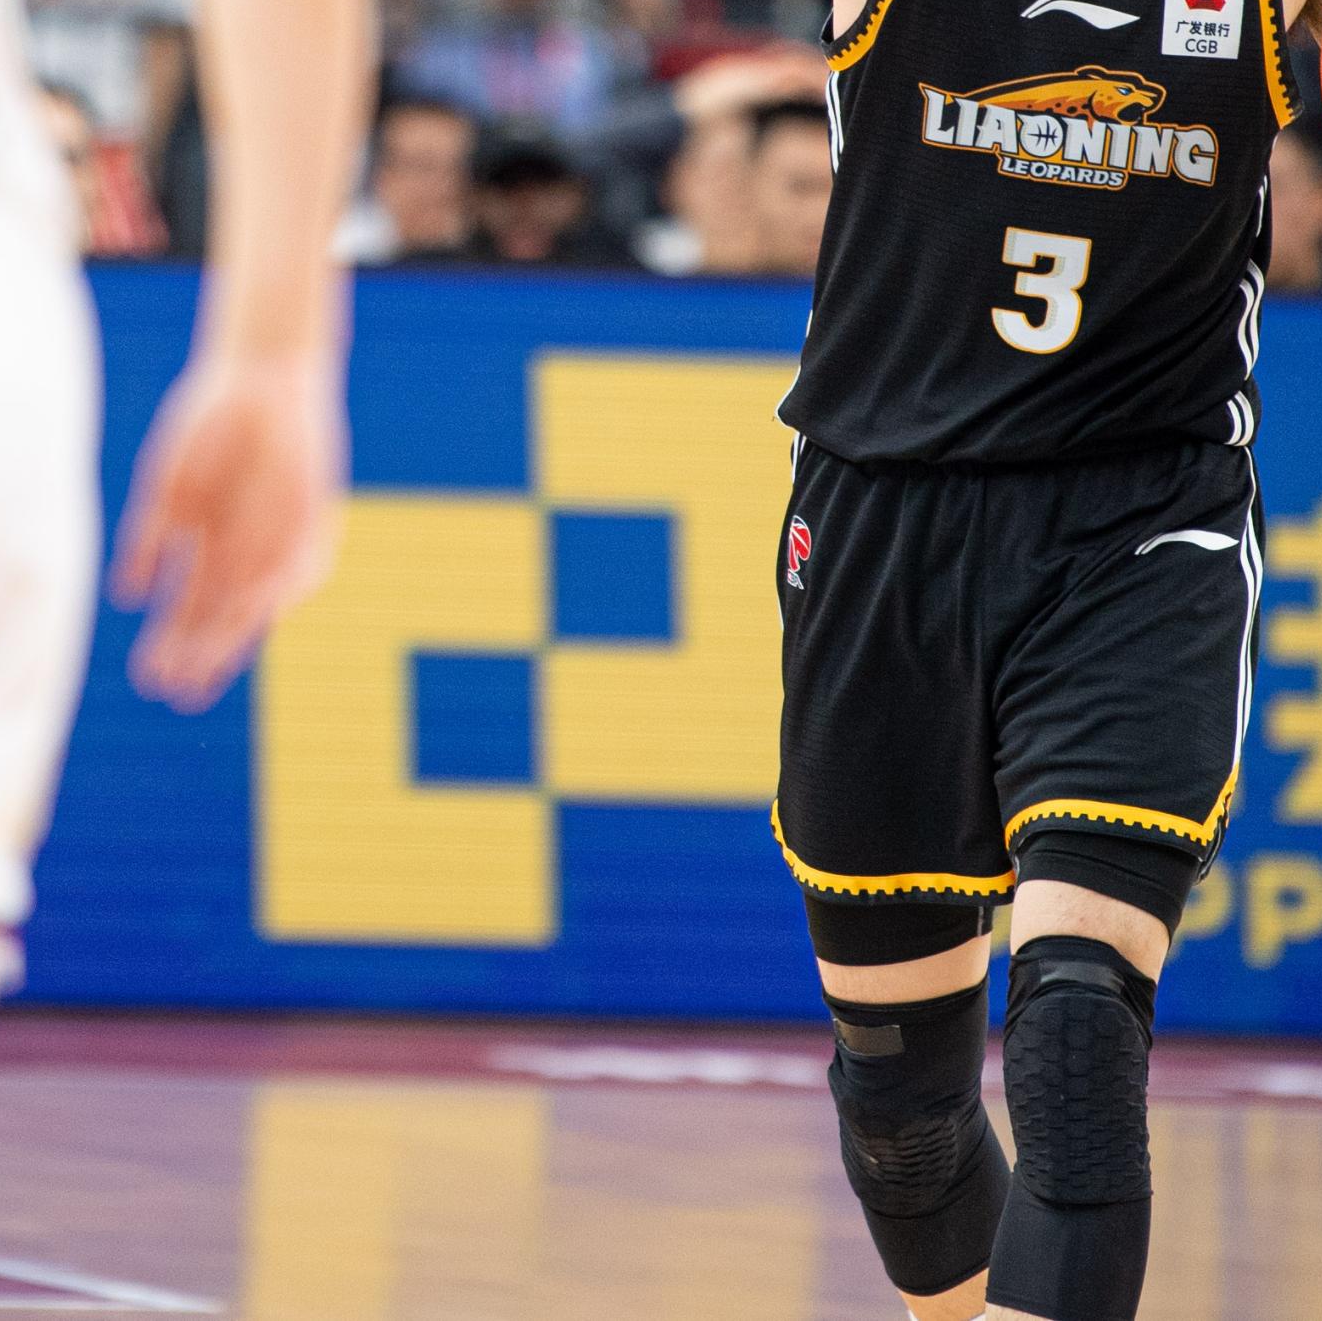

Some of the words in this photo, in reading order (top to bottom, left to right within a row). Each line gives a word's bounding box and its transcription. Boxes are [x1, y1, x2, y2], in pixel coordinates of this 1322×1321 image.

[1176, 20, 1230, 37] 广发银行
[1185, 38, 1218, 54] CGB
[922, 86, 1217, 184] LIAONING
[1001, 157, 1124, 186] LEOPARDS
[991, 226, 1092, 354] 3
